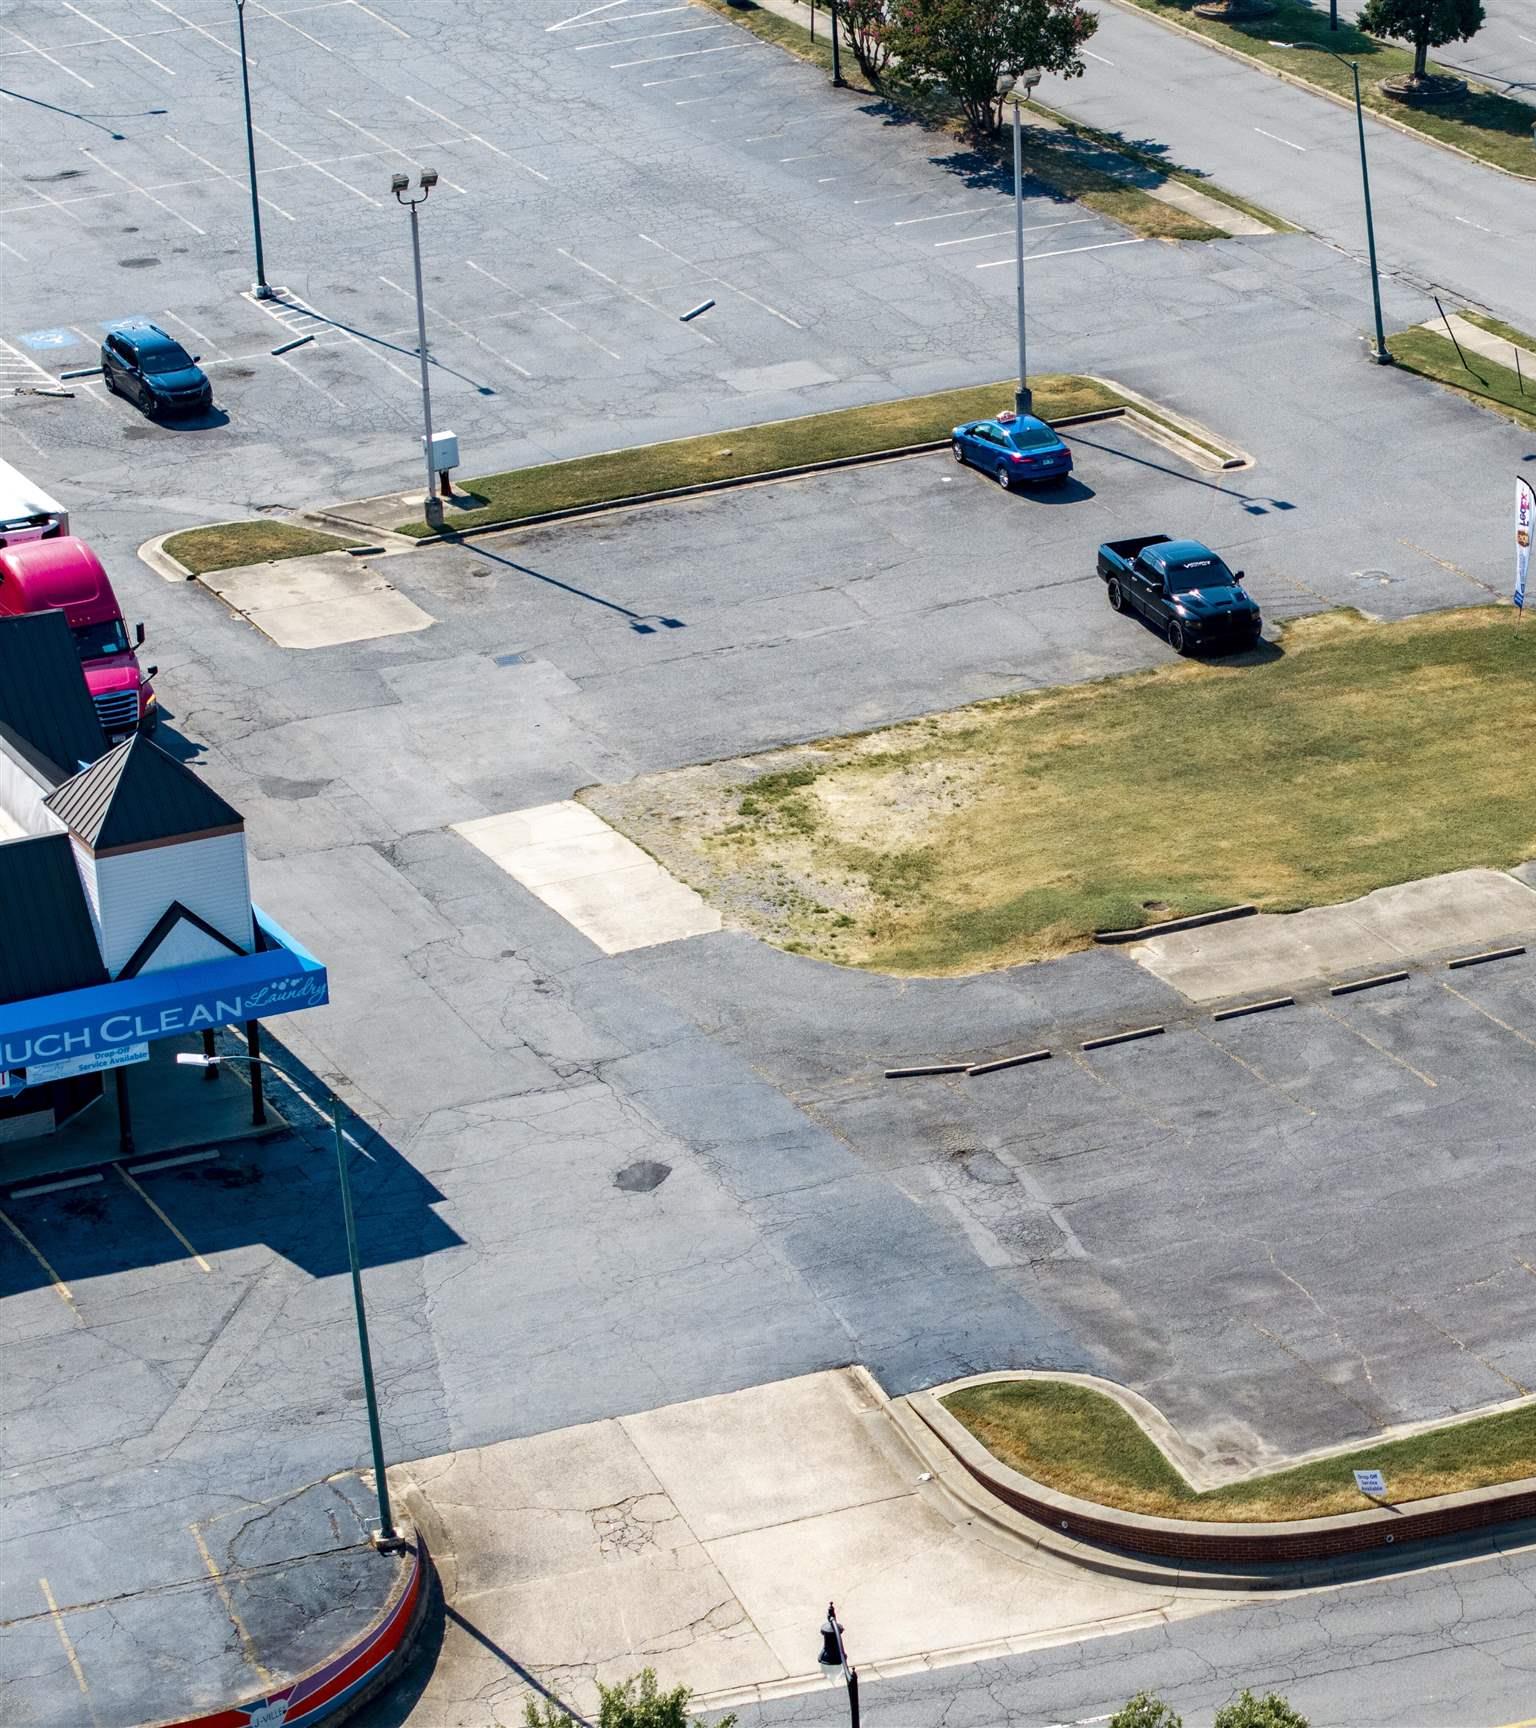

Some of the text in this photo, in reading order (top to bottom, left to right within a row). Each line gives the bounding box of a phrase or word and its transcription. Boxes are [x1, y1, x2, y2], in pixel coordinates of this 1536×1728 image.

[0, 977, 327, 1065] UCH CLEAN Laundry
[79, 1061, 107, 1072] Service
[110, 1052, 148, 1065] Available
